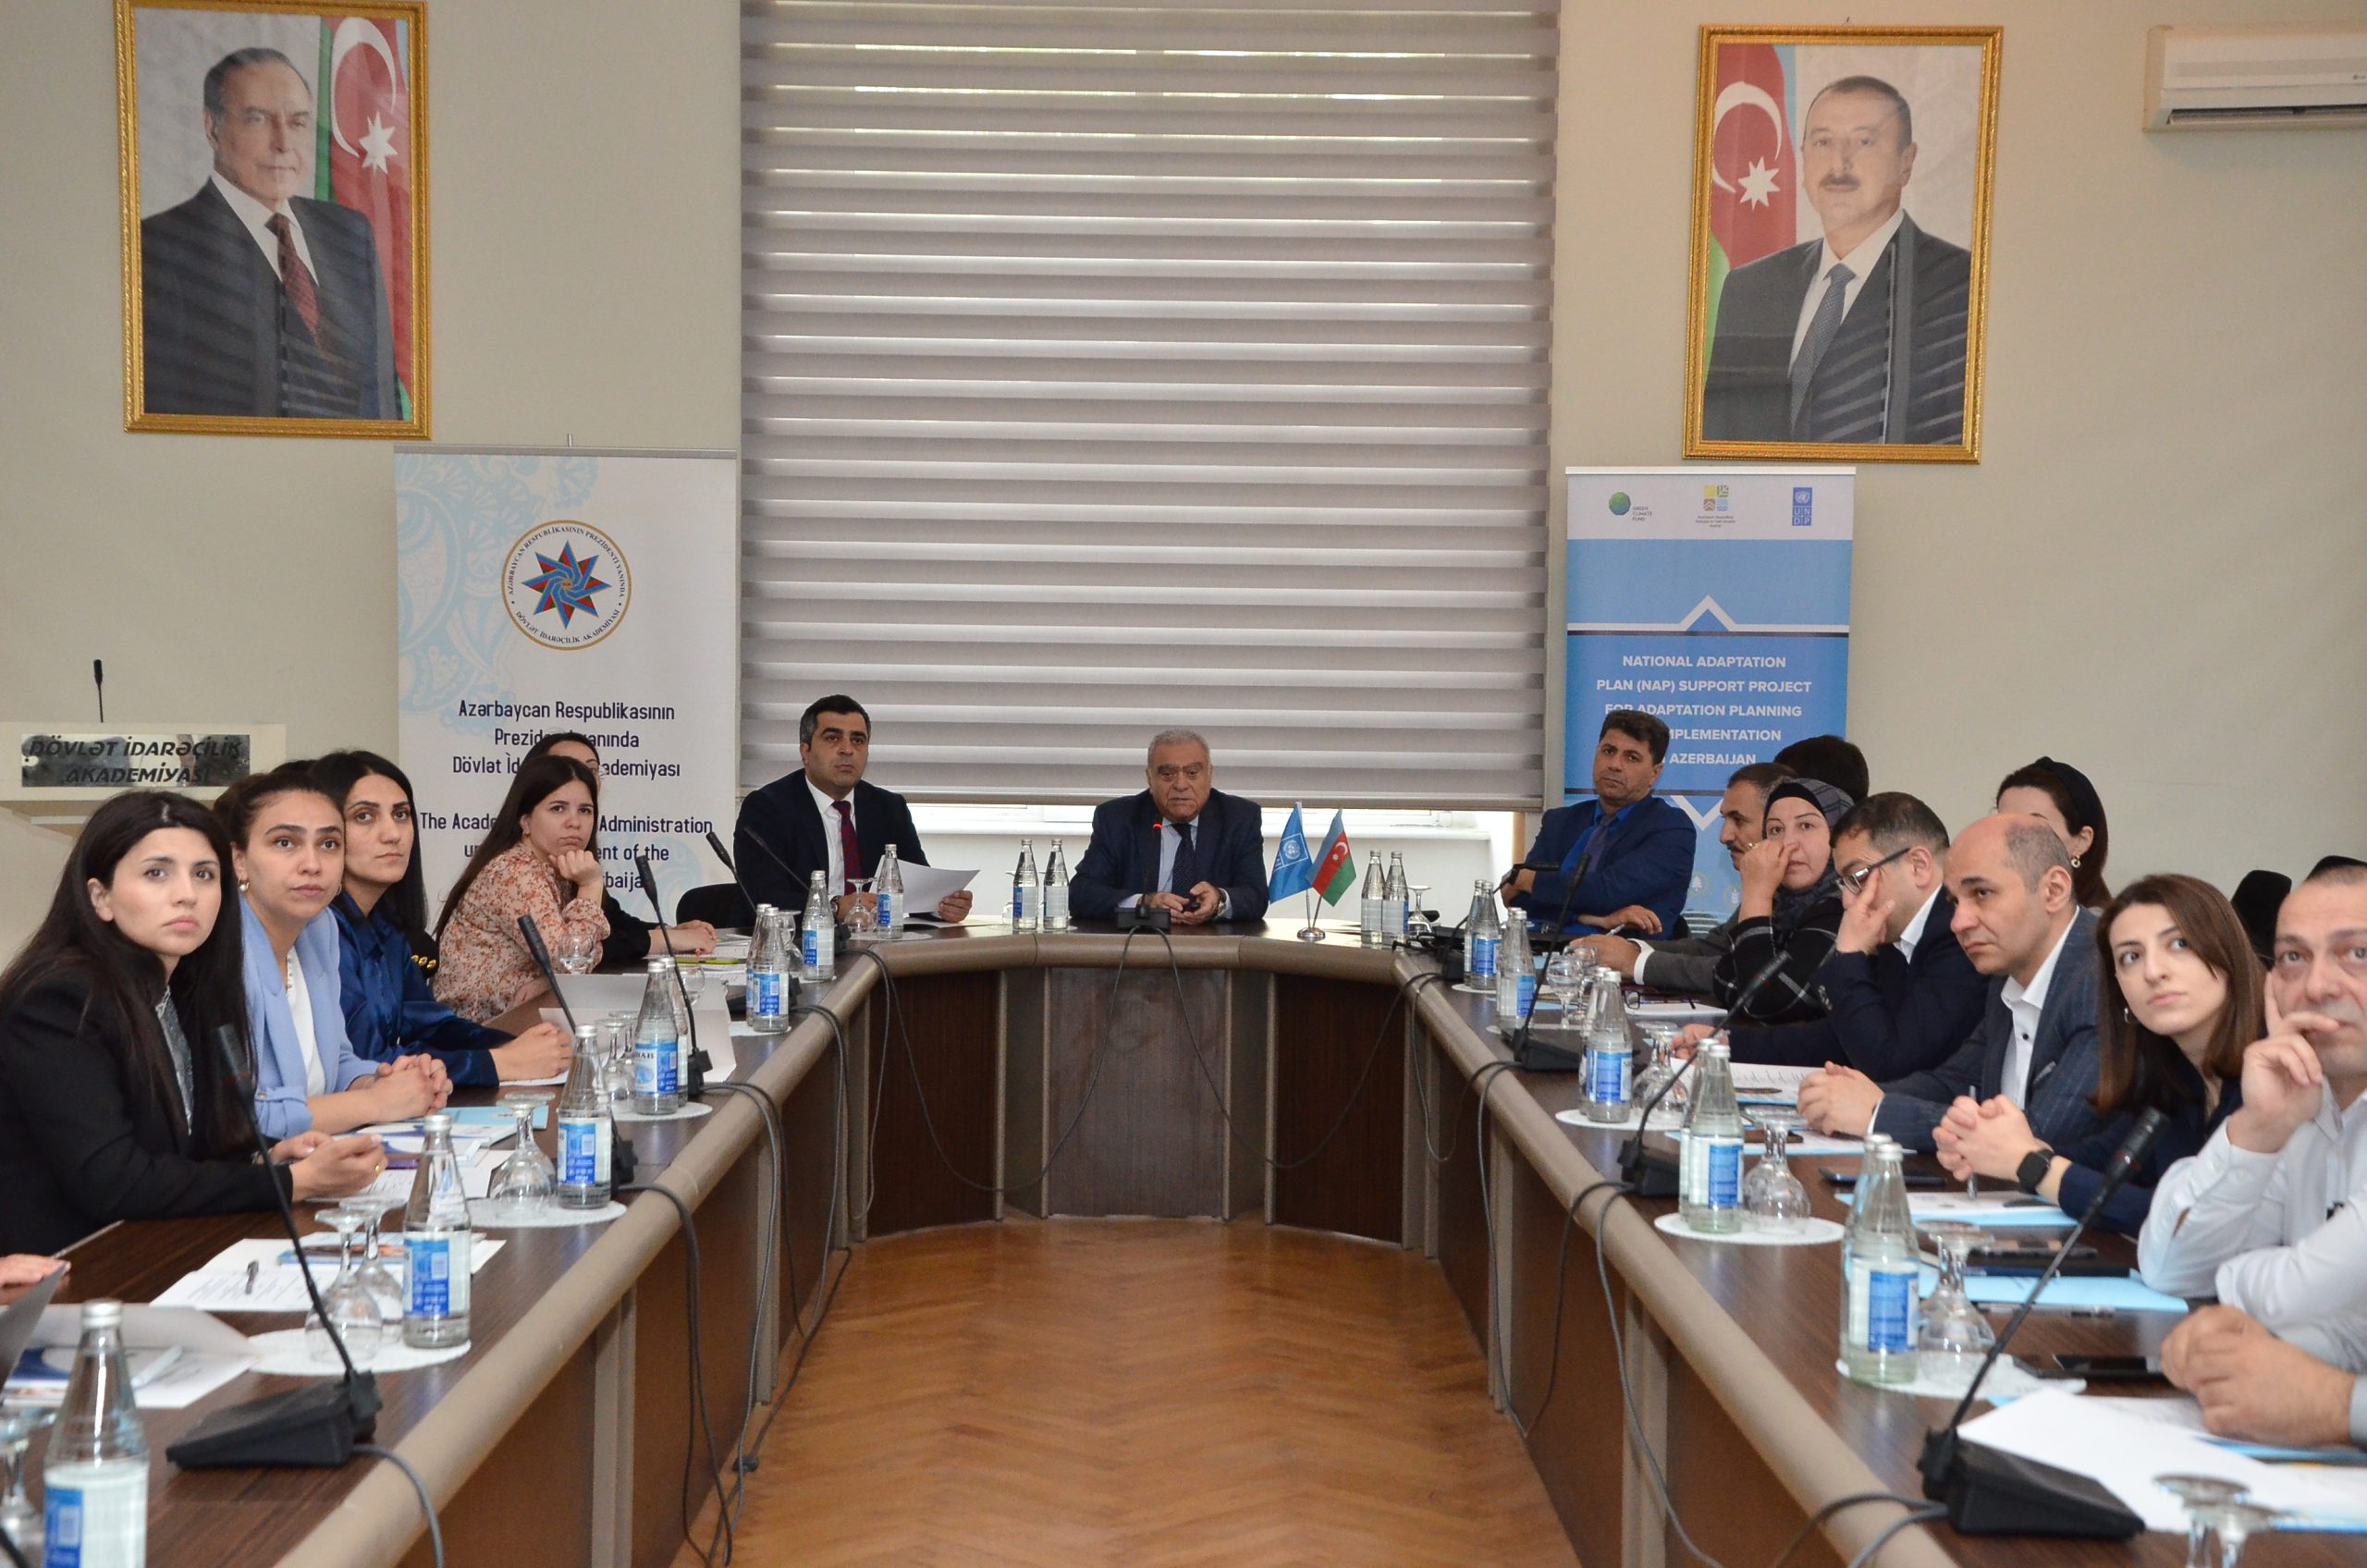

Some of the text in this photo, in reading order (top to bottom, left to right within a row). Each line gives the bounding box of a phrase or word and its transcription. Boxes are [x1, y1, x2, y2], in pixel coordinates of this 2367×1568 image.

[1623, 655, 1785, 668] NATIONAL ADAPTATION
[1597, 680, 1811, 692] PLAN (NAP) SUPPORT PROJECT
[459, 700, 675, 723] Azərbaycan Respublikasının
[1637, 704, 1725, 716] ADAPTATION
[1729, 705, 1802, 717] PLANNING
[1669, 729, 1782, 741] PLEMENTATION
[453, 756, 501, 774] Dövlət
[1669, 753, 1756, 764] AZERBAIJAN
[420, 813, 447, 830] The
[599, 815, 713, 834] Administration
